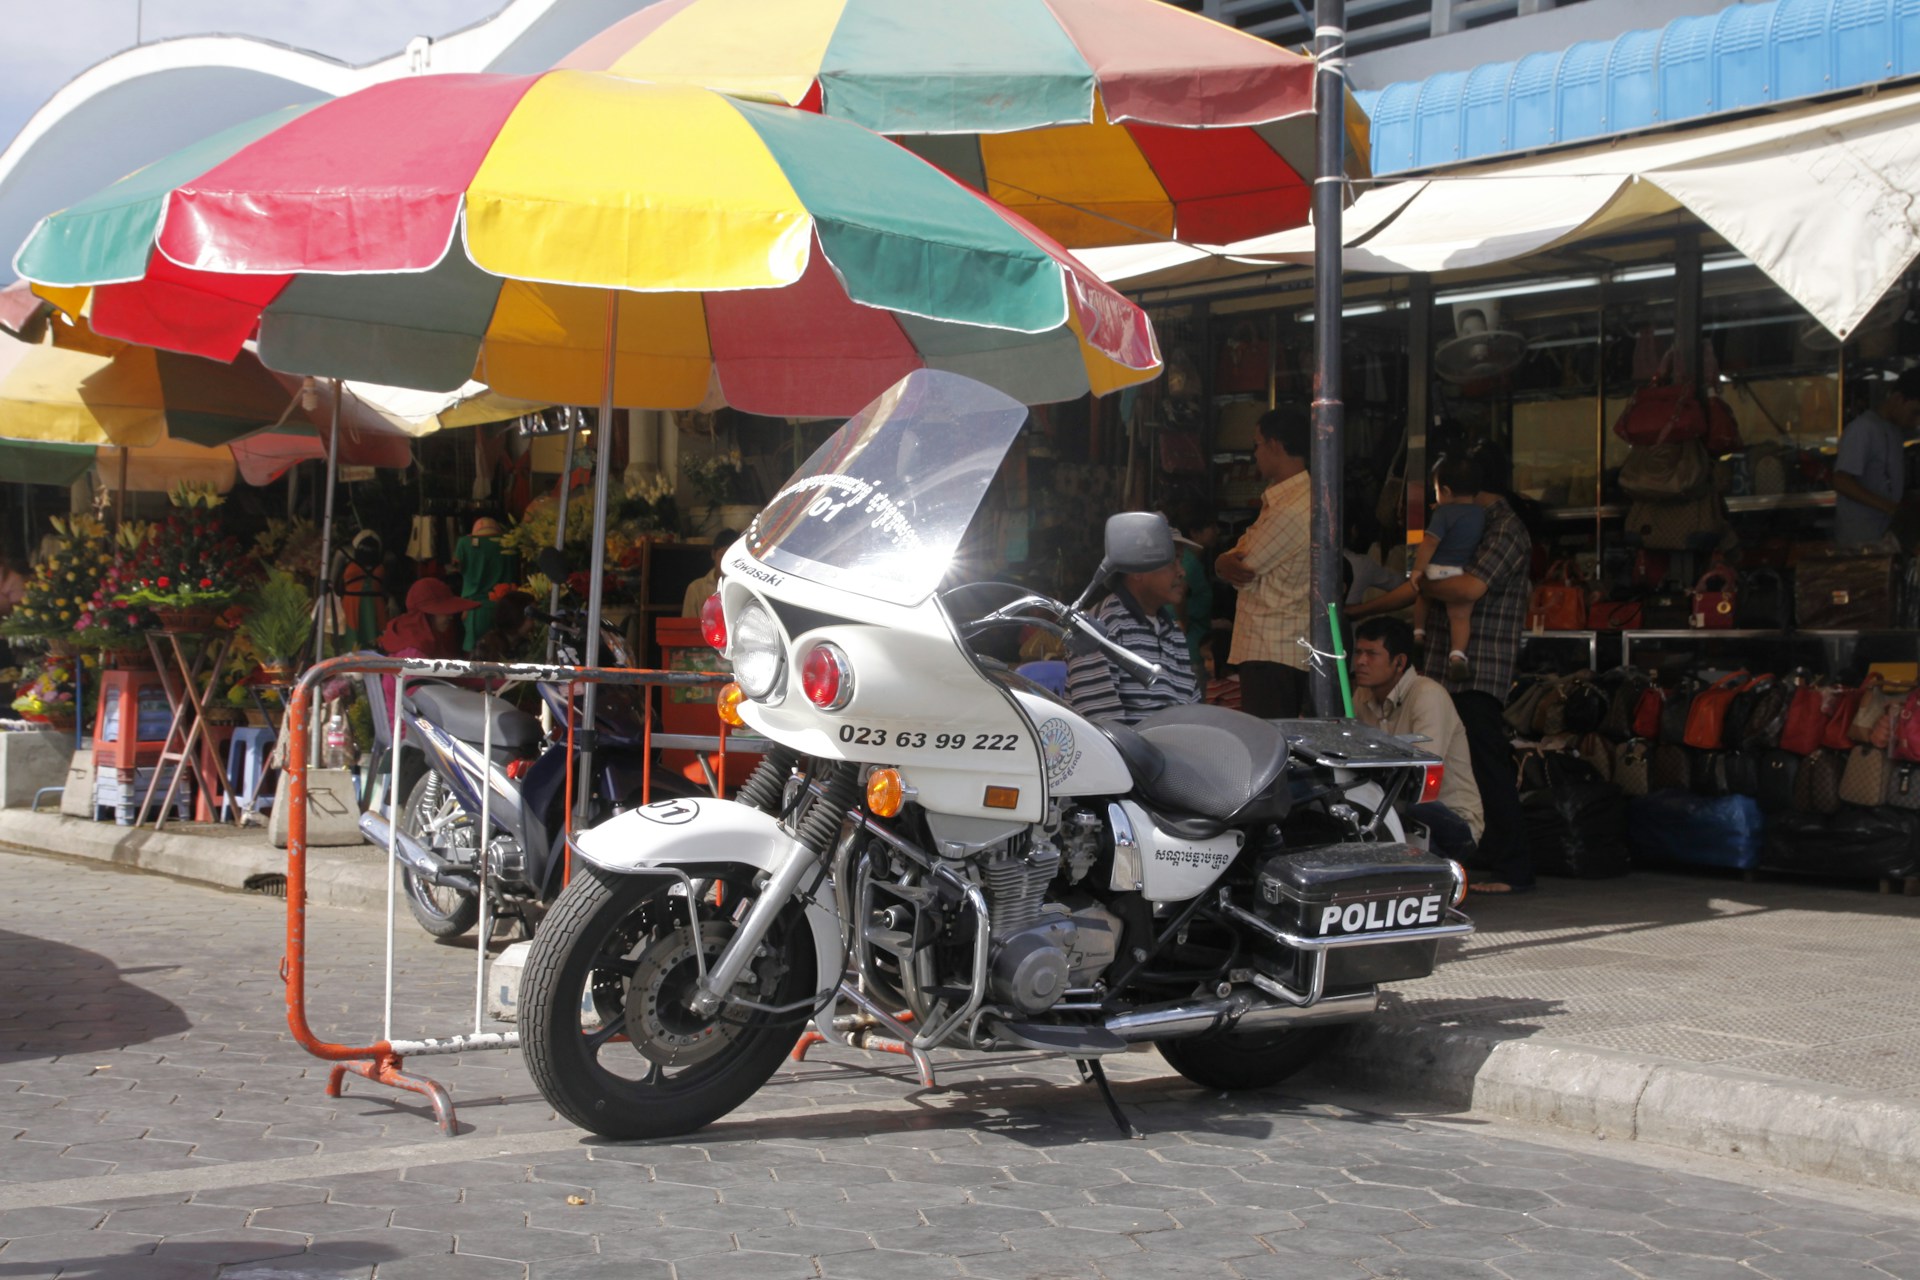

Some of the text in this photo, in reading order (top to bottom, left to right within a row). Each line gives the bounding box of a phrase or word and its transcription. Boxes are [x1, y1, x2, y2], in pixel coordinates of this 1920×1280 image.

[808, 496, 846, 523] 01
[730, 558, 785, 587] Kawasaki
[839, 724, 1019, 751] 023 63 99 222
[1319, 895, 1441, 934] POLICE
